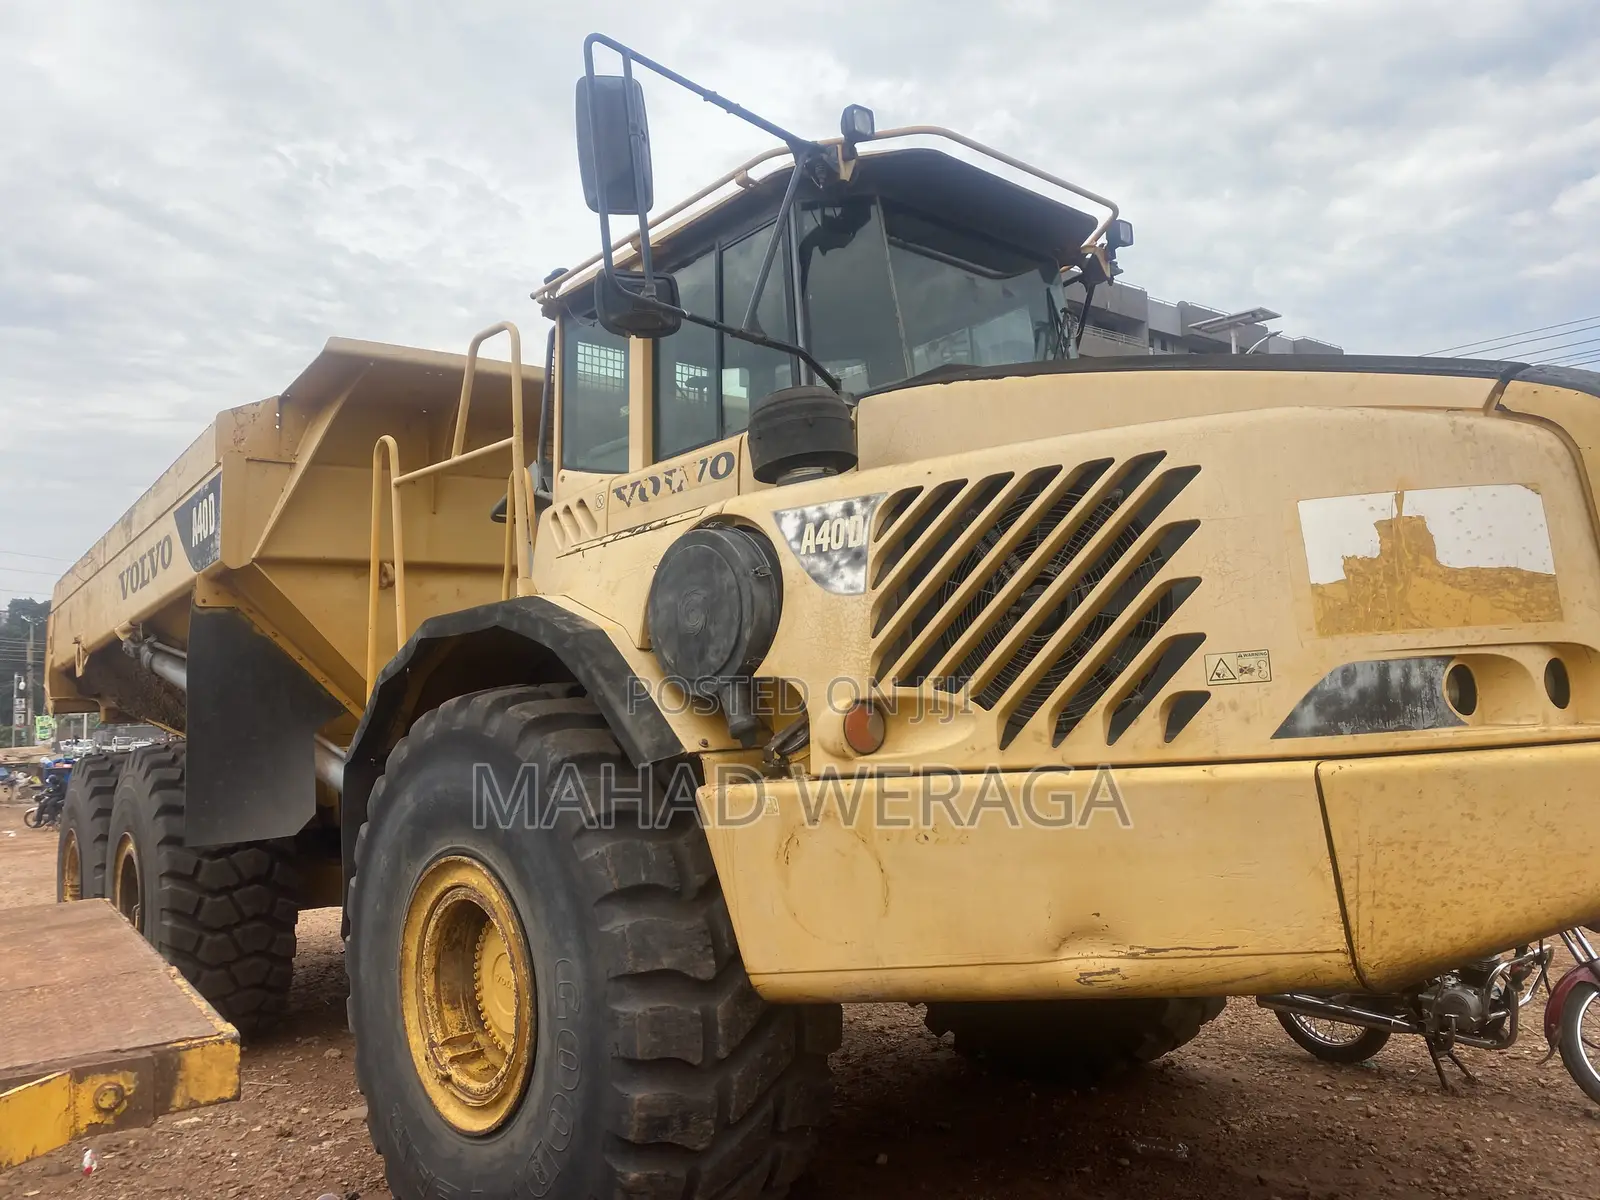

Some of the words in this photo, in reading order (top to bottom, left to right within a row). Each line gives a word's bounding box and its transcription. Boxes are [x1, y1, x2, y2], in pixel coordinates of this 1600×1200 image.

[191, 492, 215, 548] A40D
[800, 514, 865, 555] A40D
[118, 534, 173, 601] VOLVO
